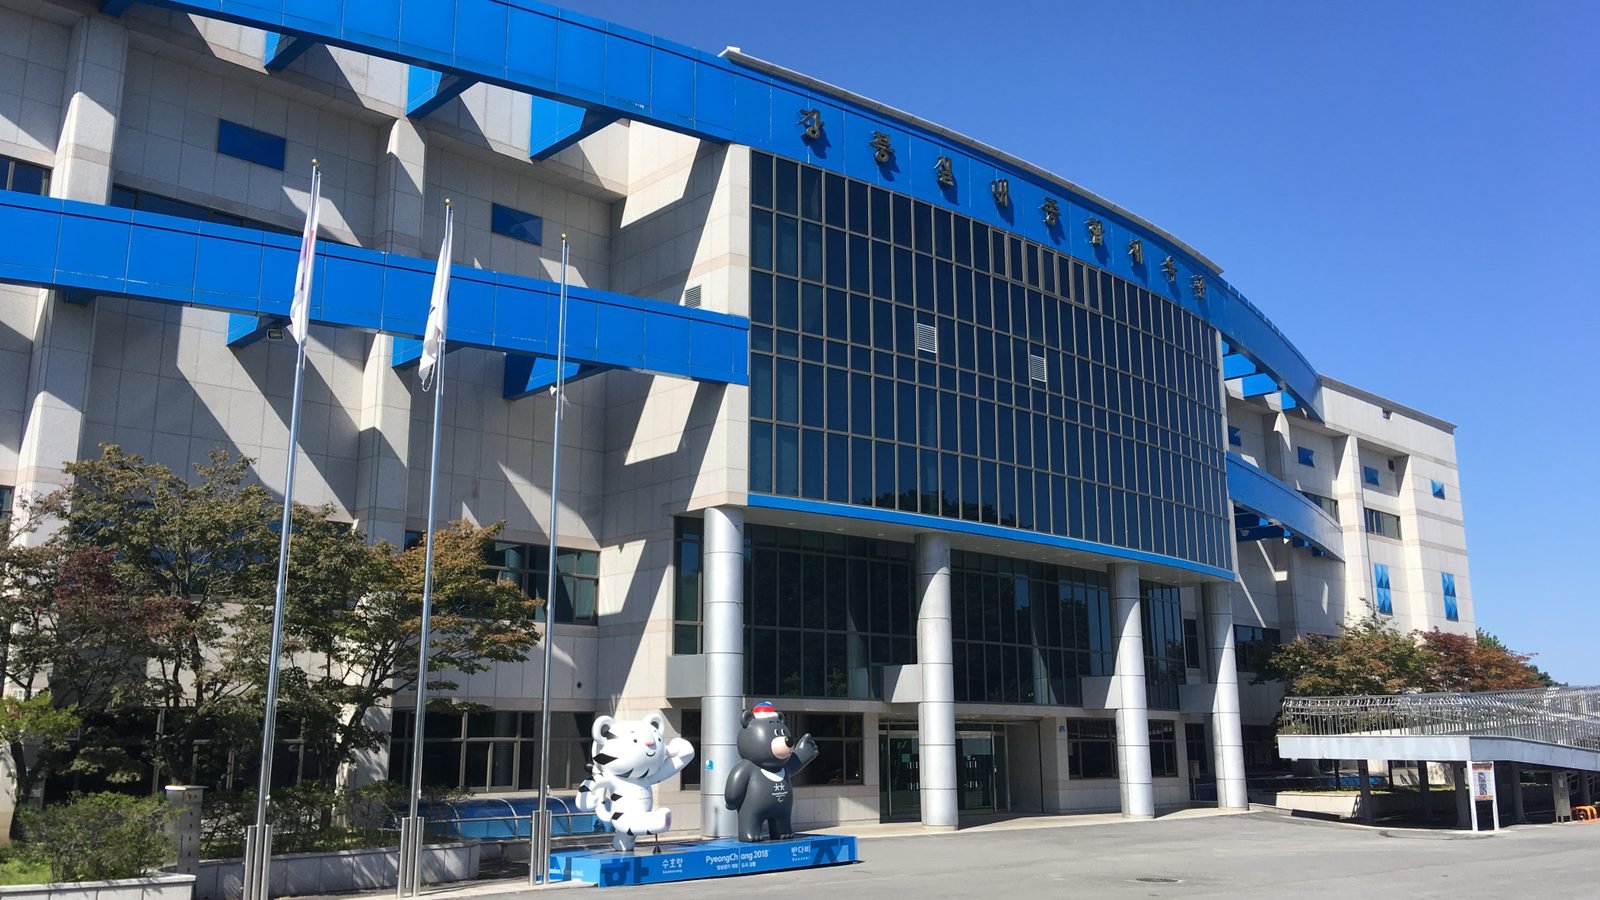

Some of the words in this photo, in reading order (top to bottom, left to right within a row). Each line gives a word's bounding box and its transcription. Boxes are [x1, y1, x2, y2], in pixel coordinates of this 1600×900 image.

[705, 852, 753, 865] PyeongChang
[753, 849, 769, 859] 2018
[791, 844, 811, 857] 반다비
[662, 857, 683, 869] 수호랑
